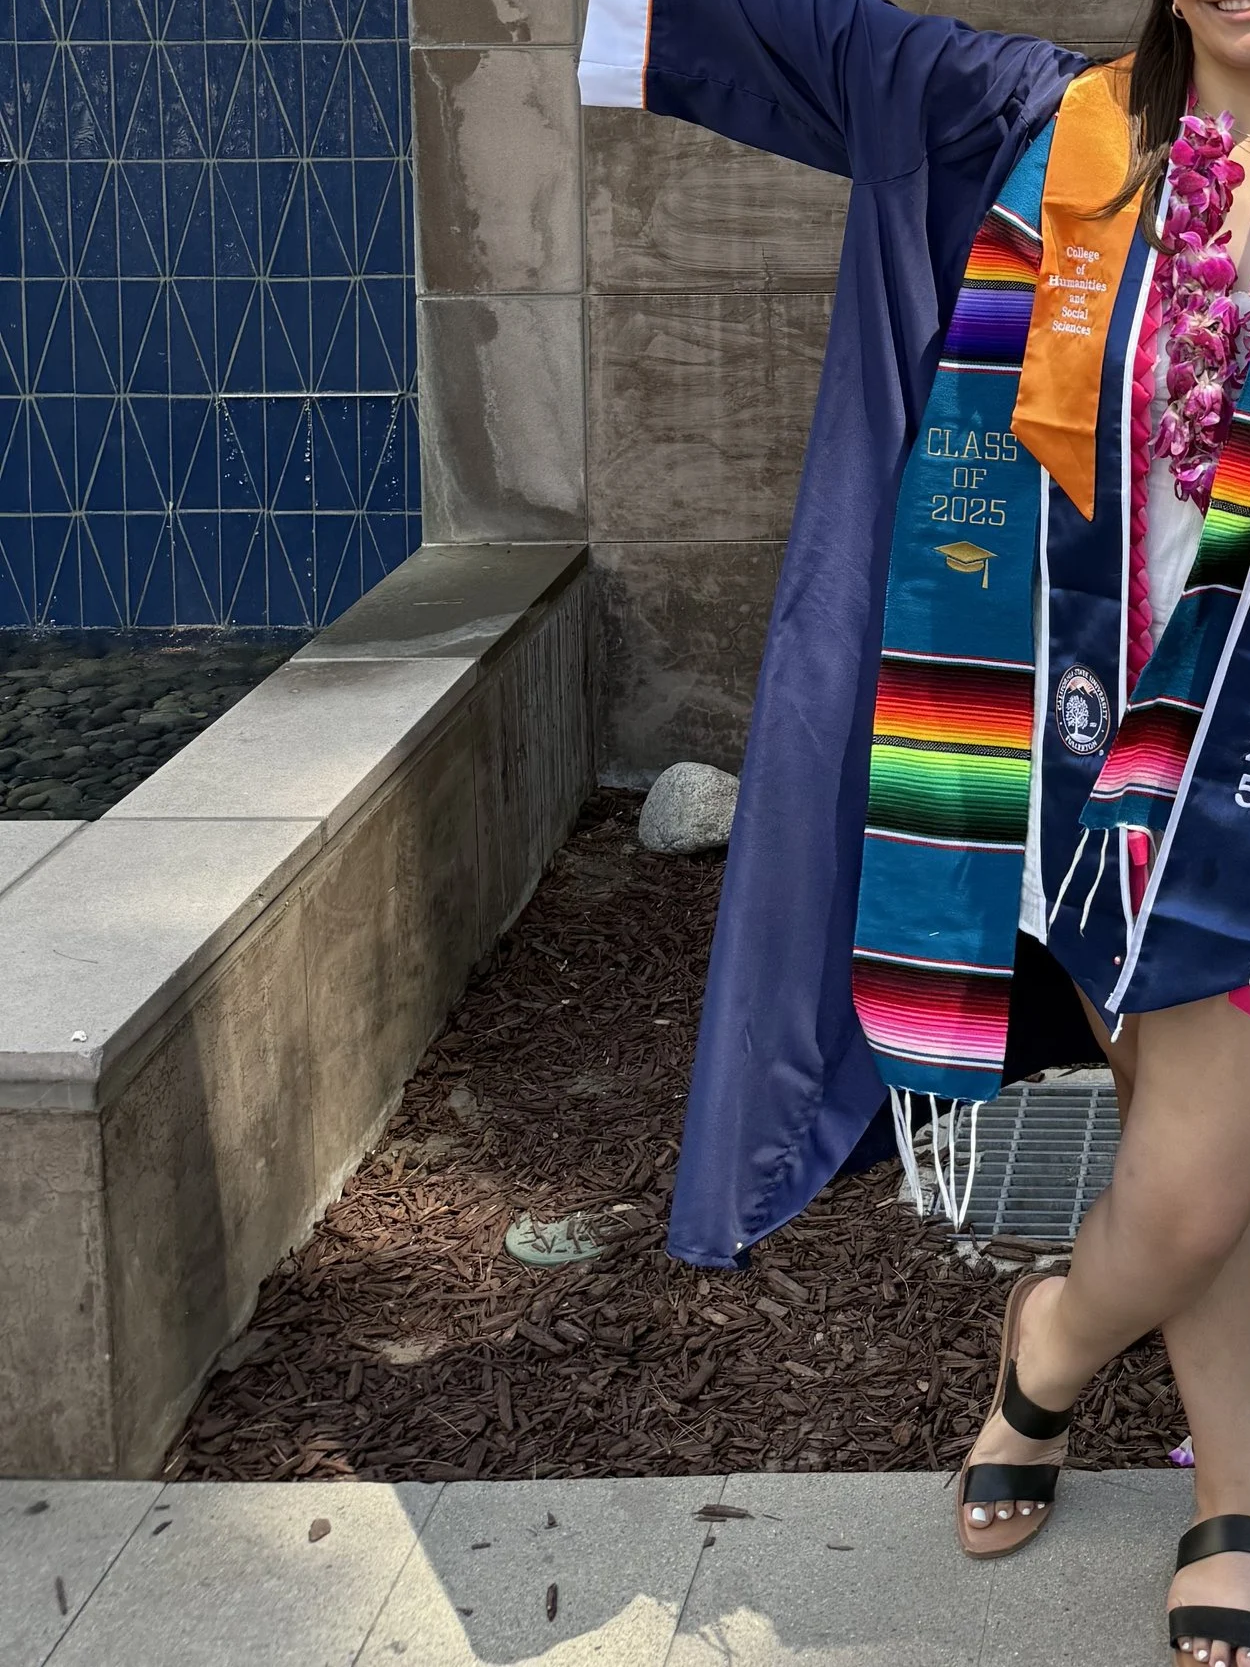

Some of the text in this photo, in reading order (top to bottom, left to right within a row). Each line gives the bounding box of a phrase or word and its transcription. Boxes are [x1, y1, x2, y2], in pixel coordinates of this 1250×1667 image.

[1066, 246, 1100, 262] College
[1076, 264, 1087, 275] of
[1048, 275, 1107, 292] Humanities
[1069, 294, 1086, 304] and
[1061, 306, 1088, 320] Social
[1052, 320, 1091, 335] Sciences
[927, 427, 1018, 462] CLASS
[953, 467, 987, 489] OF
[931, 495, 1007, 526] 2025
